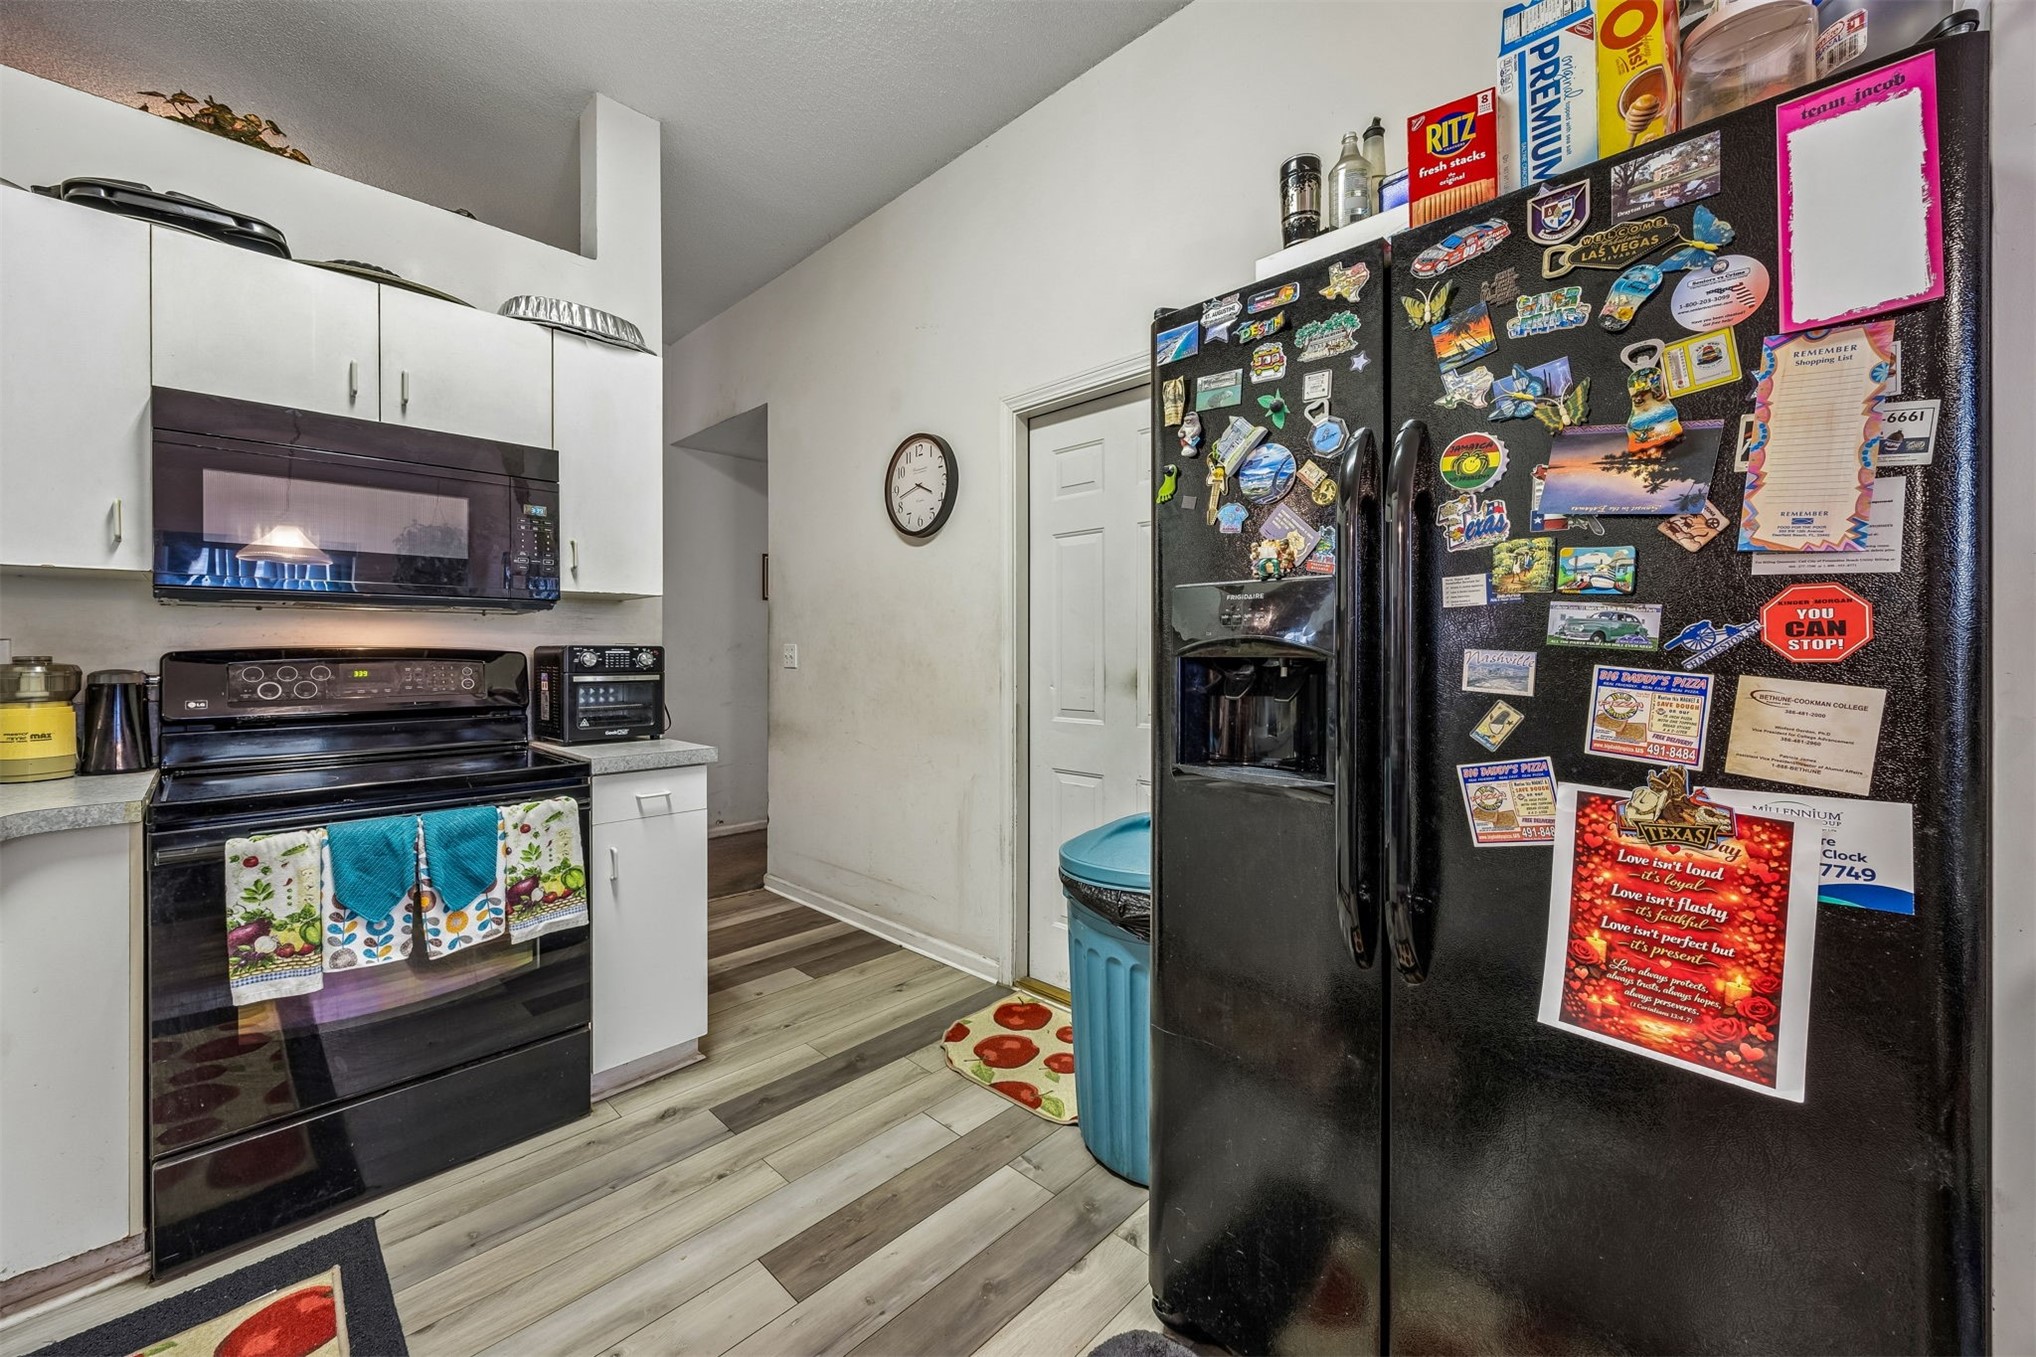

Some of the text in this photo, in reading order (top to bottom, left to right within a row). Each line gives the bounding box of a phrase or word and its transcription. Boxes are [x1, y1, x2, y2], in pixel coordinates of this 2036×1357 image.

[1481, 94, 1489, 104] 8
[1801, 72, 1905, 119] team jacob
[1426, 111, 1476, 154] RITZ
[1419, 151, 1486, 178] fresh stacks
[1439, 173, 1465, 185] original
[1582, 218, 1665, 246] WELCOME
[1581, 235, 1660, 262] LAS VEGAS
[1601, 250, 1637, 262] NEVADA
[1691, 277, 1716, 286] Seniors
[1725, 270, 1746, 279] Crime
[1793, 344, 1858, 358] REMEMBER
[1795, 354, 1853, 367] Shopping List
[915, 444, 923, 457] 12
[1450, 442, 1493, 453] JAMAICA
[905, 452, 912, 464] 11
[897, 466, 905, 479] 10
[894, 485, 900, 497] 9
[897, 501, 904, 514] 8
[906, 512, 912, 525] 7
[917, 516, 923, 527] 6
[1226, 592, 1265, 601] FRIGIDAIRE
[1796, 607, 1834, 620] YOU
[1785, 620, 1847, 637] CAN
[1787, 638, 1844, 650] STOP!
[1465, 650, 1535, 668] Nashville
[1599, 670, 1708, 690] BIG DADDY'S PIZZA
[1676, 702, 1700, 710] DOUGH
[1760, 694, 1869, 712] BETHUNE-COOKMAN COLLEGE
[1666, 735, 1694, 746] DELIVERY!
[1796, 733, 1817, 741] College
[1818, 736, 1855, 745] Advancement
[1647, 743, 1696, 760] 491-8484
[1463, 761, 1548, 778] BIG DADDY'S PIZZA
[1521, 827, 1555, 838] 491-848
[1644, 826, 1706, 844] TEXAS
[1822, 849, 1868, 863] Clock
[1617, 849, 1724, 880] Love isn't loud
[1819, 863, 1876, 882] 7749
[1664, 873, 1706, 892] loyal
[1610, 883, 1729, 923] Love isn't flashy
[1645, 909, 1709, 930] faithful
[1600, 915, 1736, 957] Love isn't perfect but
[1649, 945, 1706, 965] present
[1608, 958, 1709, 993] Love always protects,
[1606, 971, 1722, 1009] always trusts, always hopes,
[1624, 988, 1700, 1016] always perseveres.
